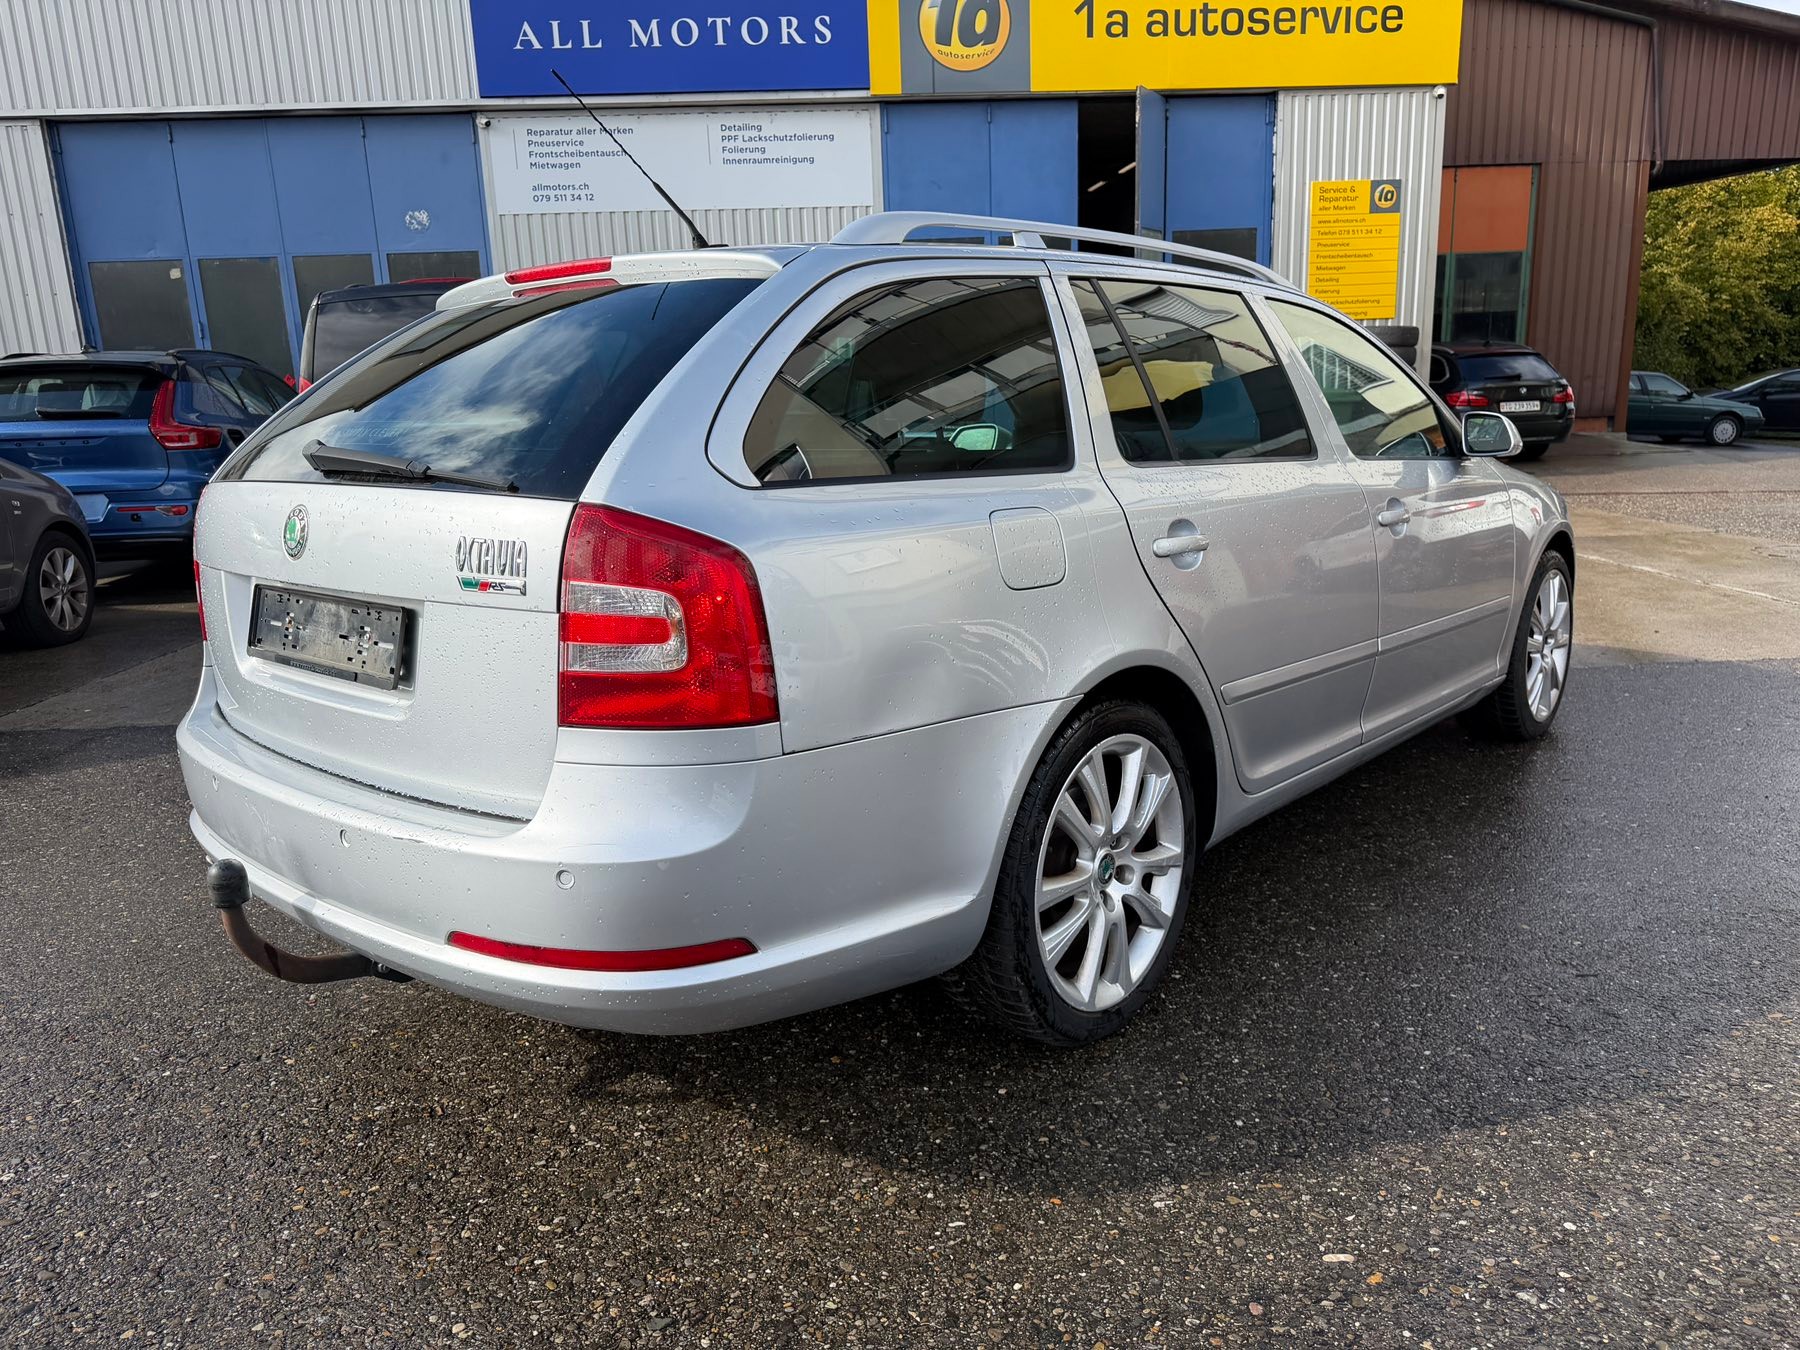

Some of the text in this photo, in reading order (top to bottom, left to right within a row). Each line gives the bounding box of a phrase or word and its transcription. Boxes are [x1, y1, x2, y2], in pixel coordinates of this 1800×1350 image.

[1074, 0, 1404, 38] 1a autoservice
[513, 15, 833, 51] ALL MOTORS
[937, 48, 995, 60] autoservice
[526, 128, 573, 138] Reparatur
[576, 127, 597, 136] aller
[720, 123, 762, 132] Detailing
[527, 138, 585, 148] Pneuservice
[721, 133, 835, 143] PPF Lackschutzfolierung
[528, 149, 627, 159] Frontscheibentausch
[722, 145, 766, 155] Folierung
[722, 155, 815, 165] Innenraumreinigung
[529, 161, 581, 171] Mietwagen
[532, 182, 590, 192] allmotors.ch
[1319, 185, 1356, 194] Service &
[532, 193, 595, 203] 079 511 34 12
[1318, 195, 1359, 204] Reparatur
[455, 535, 528, 578] OCTAVIA
[488, 581, 506, 591] RS
